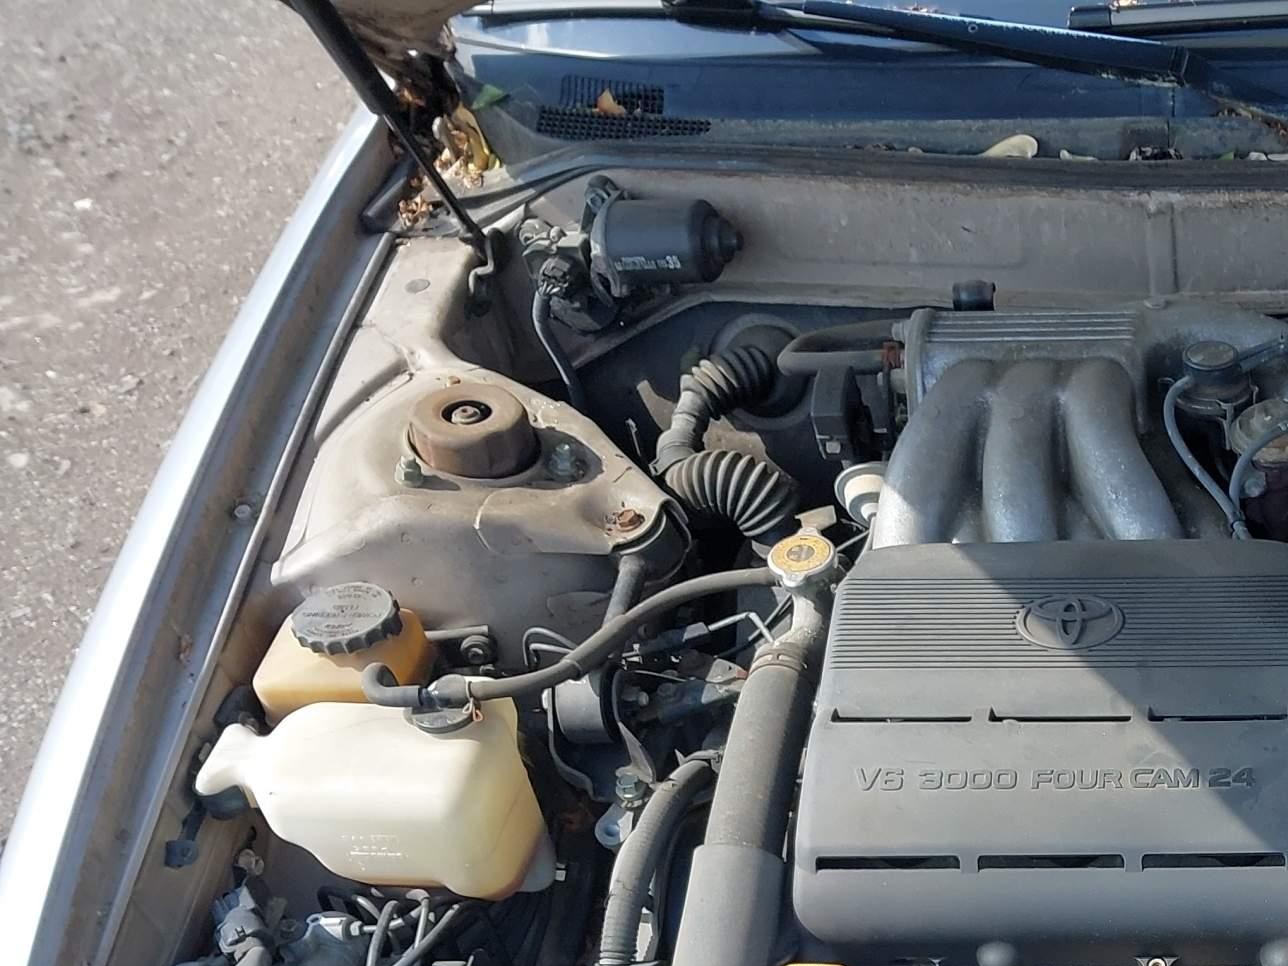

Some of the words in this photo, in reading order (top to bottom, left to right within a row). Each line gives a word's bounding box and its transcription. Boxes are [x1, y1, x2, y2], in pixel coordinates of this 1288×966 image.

[855, 767, 904, 791] V6
[918, 767, 1018, 791] 3000
[1030, 766, 1123, 790] FOUR
[1128, 766, 1201, 789] CAM
[1207, 766, 1257, 788] 24
